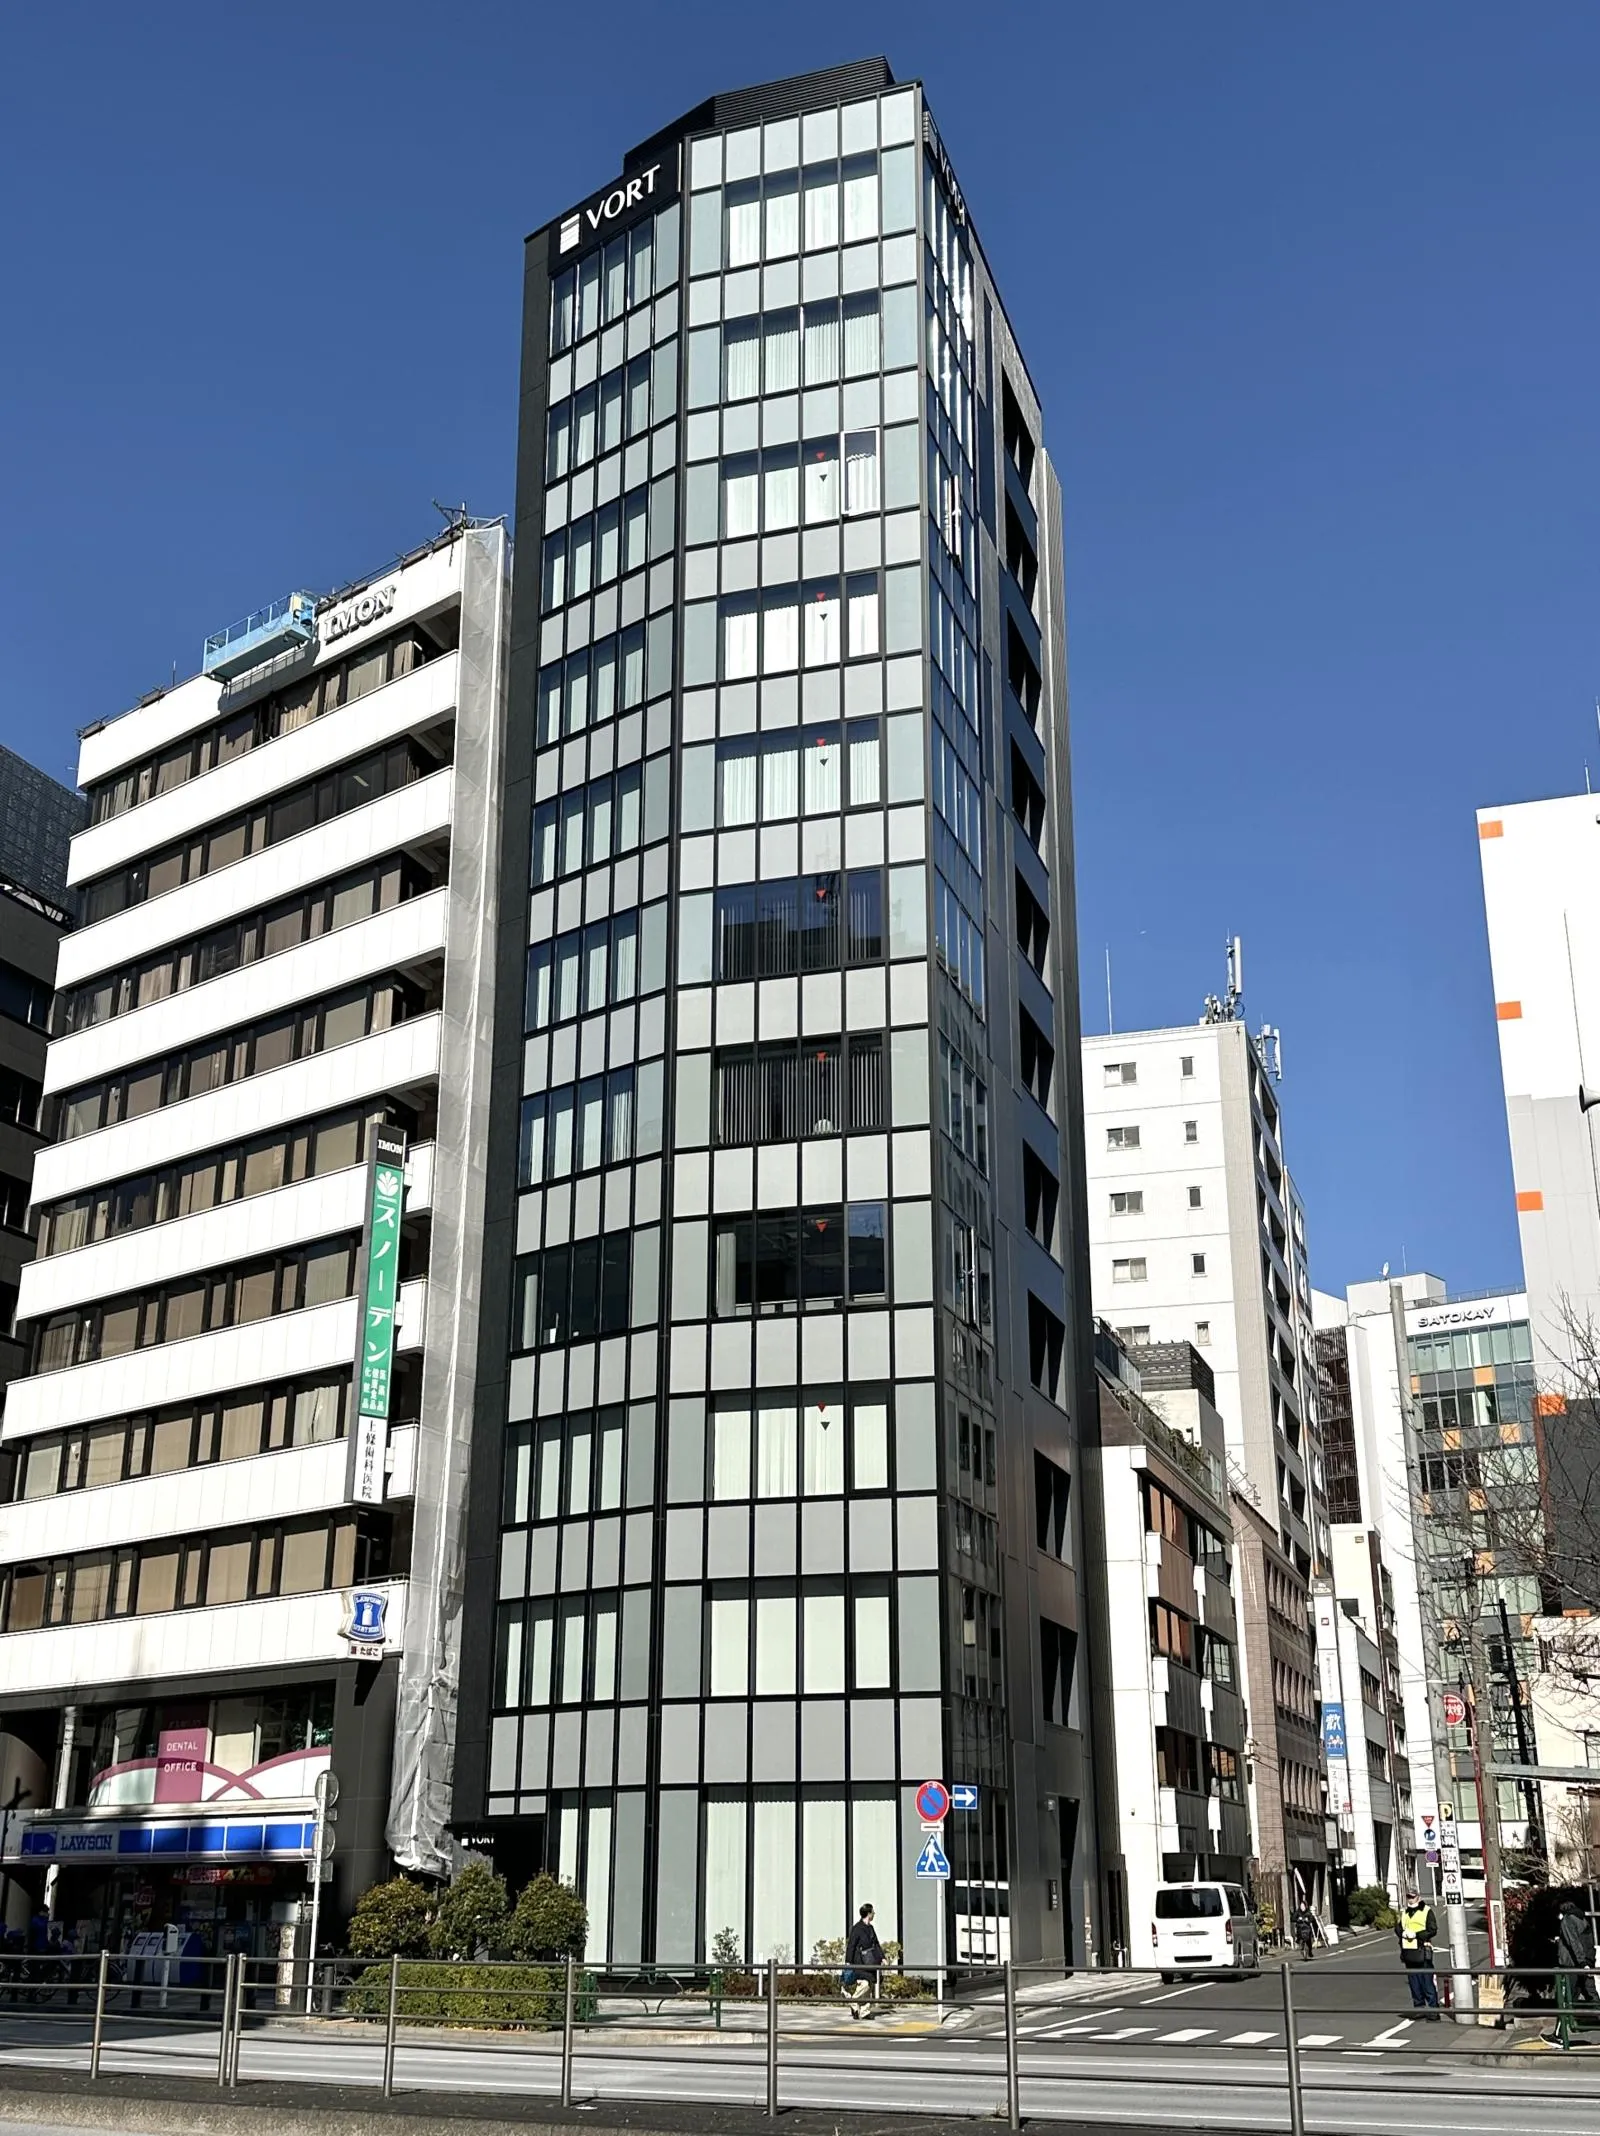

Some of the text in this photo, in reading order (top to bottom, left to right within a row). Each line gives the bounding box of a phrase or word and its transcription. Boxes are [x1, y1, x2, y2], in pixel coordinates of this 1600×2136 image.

[586, 164, 661, 230] VORT
[324, 585, 396, 645] IMON
[377, 1139, 403, 1154] IMON
[366, 1204, 396, 1363] スノーデン
[1417, 1306, 1495, 1328] SATOKAY
[360, 1646, 379, 1657] たばこ
[166, 1741, 198, 1751] DENTAL
[164, 1762, 197, 1772] OFFICE
[1440, 1804, 1452, 1821] P
[60, 1834, 113, 1851] LAWSON
